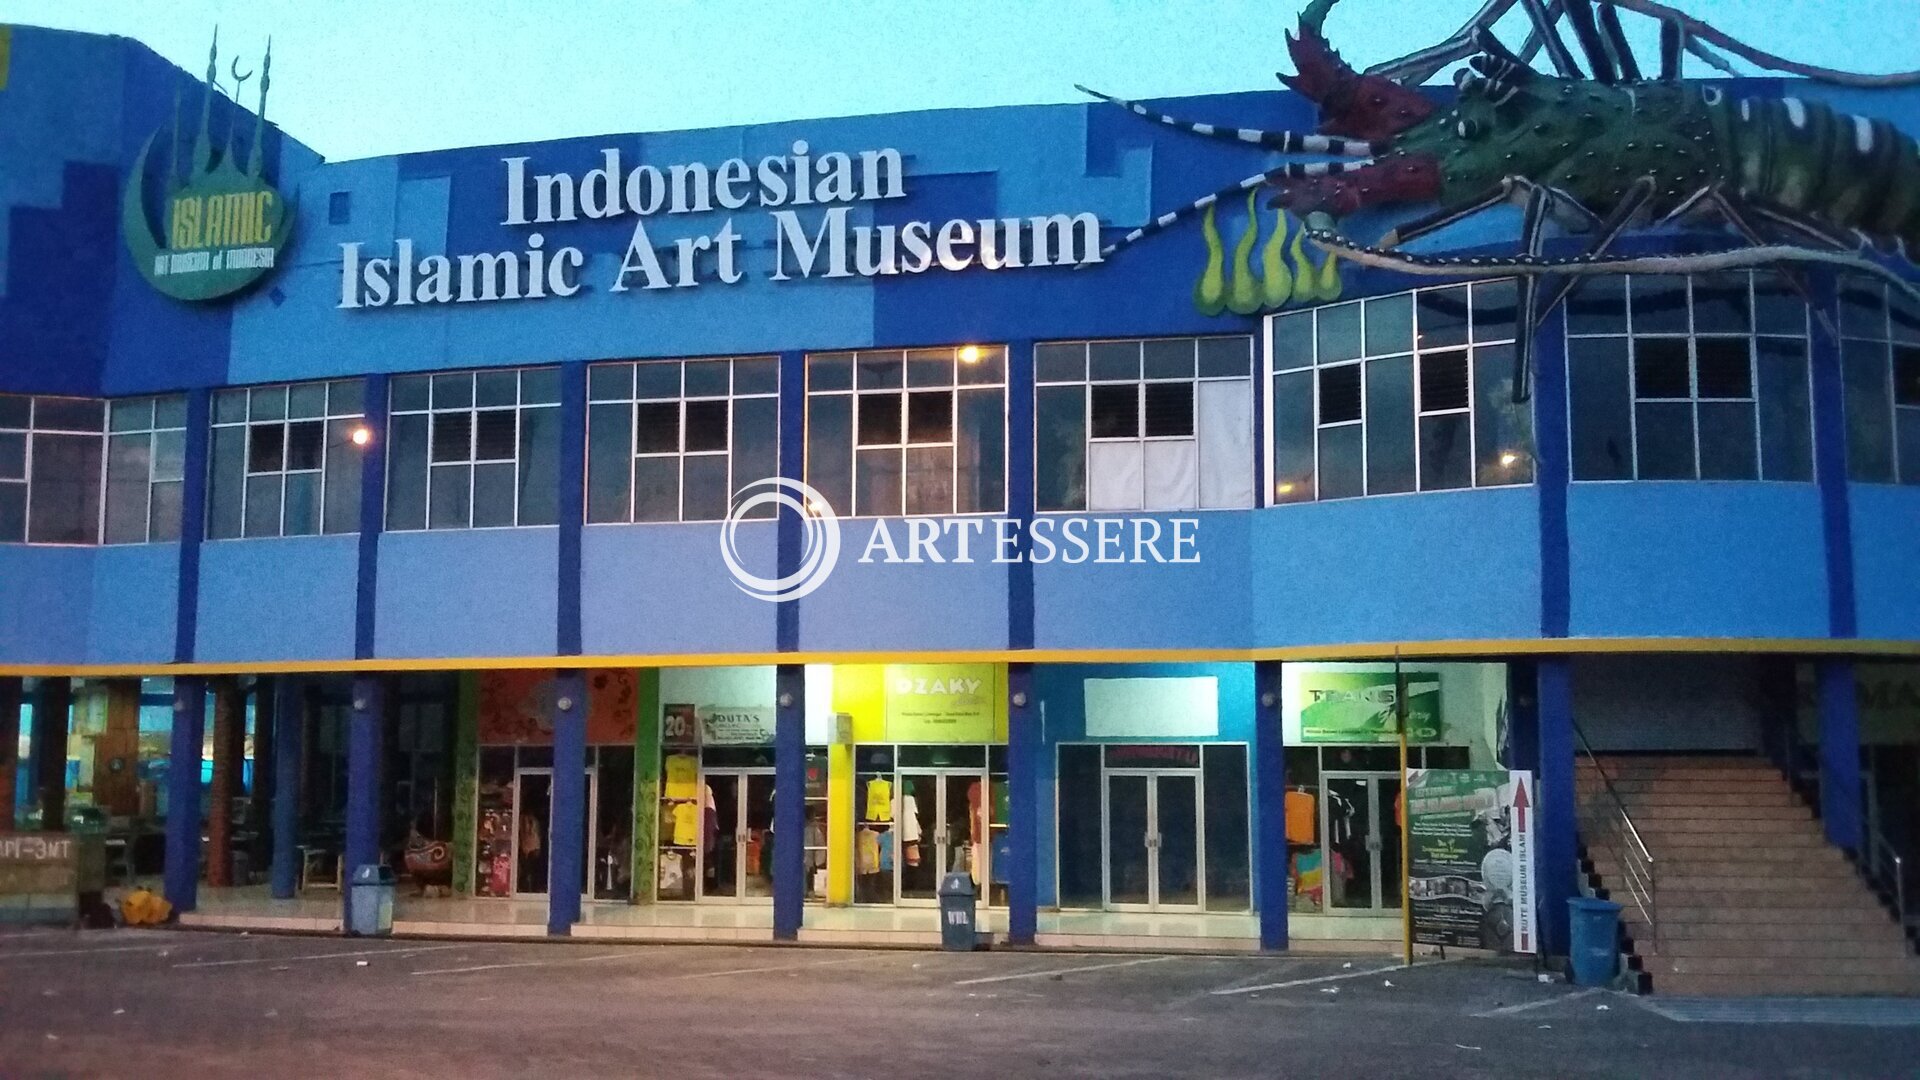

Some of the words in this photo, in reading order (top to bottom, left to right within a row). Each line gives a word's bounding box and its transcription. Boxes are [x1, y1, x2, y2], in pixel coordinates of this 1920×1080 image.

[500, 139, 907, 228] Indonesian
[172, 191, 273, 249] ISLAMIC
[335, 233, 583, 311] Islamic
[608, 215, 744, 294] Art
[768, 206, 1105, 283] Museum
[895, 676, 983, 695] DZAKY
[1308, 689, 1396, 703] TRANS
[717, 713, 761, 724] DUTA'S
[1518, 834, 1527, 862] ISLAM
[1519, 865, 1527, 904] MUSEUM
[1521, 907, 1529, 932] RUTE
